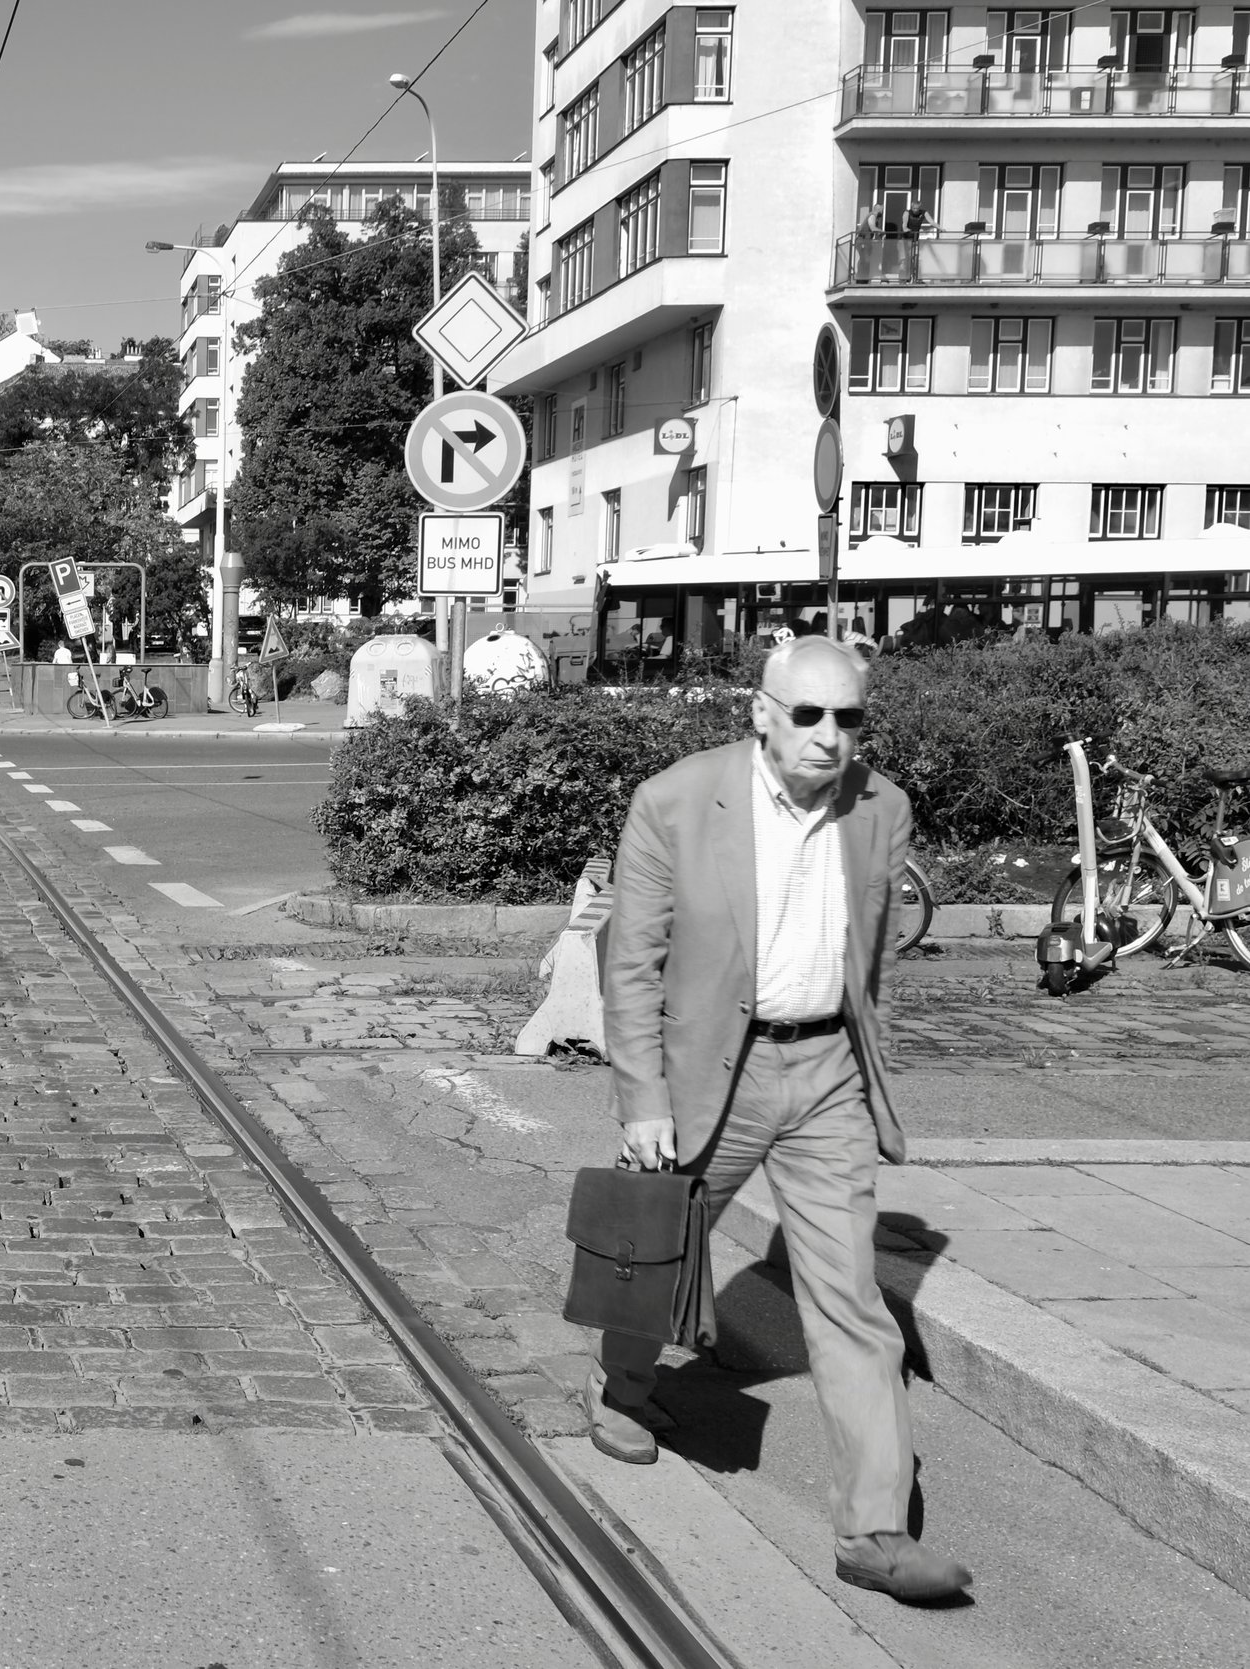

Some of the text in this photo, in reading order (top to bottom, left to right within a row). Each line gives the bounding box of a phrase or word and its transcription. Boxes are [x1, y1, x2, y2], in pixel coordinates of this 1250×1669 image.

[661, 429, 690, 440] LIDL
[441, 537, 481, 550] MIMO
[427, 556, 494, 570] BUS MHD
[55, 563, 71, 586] P
